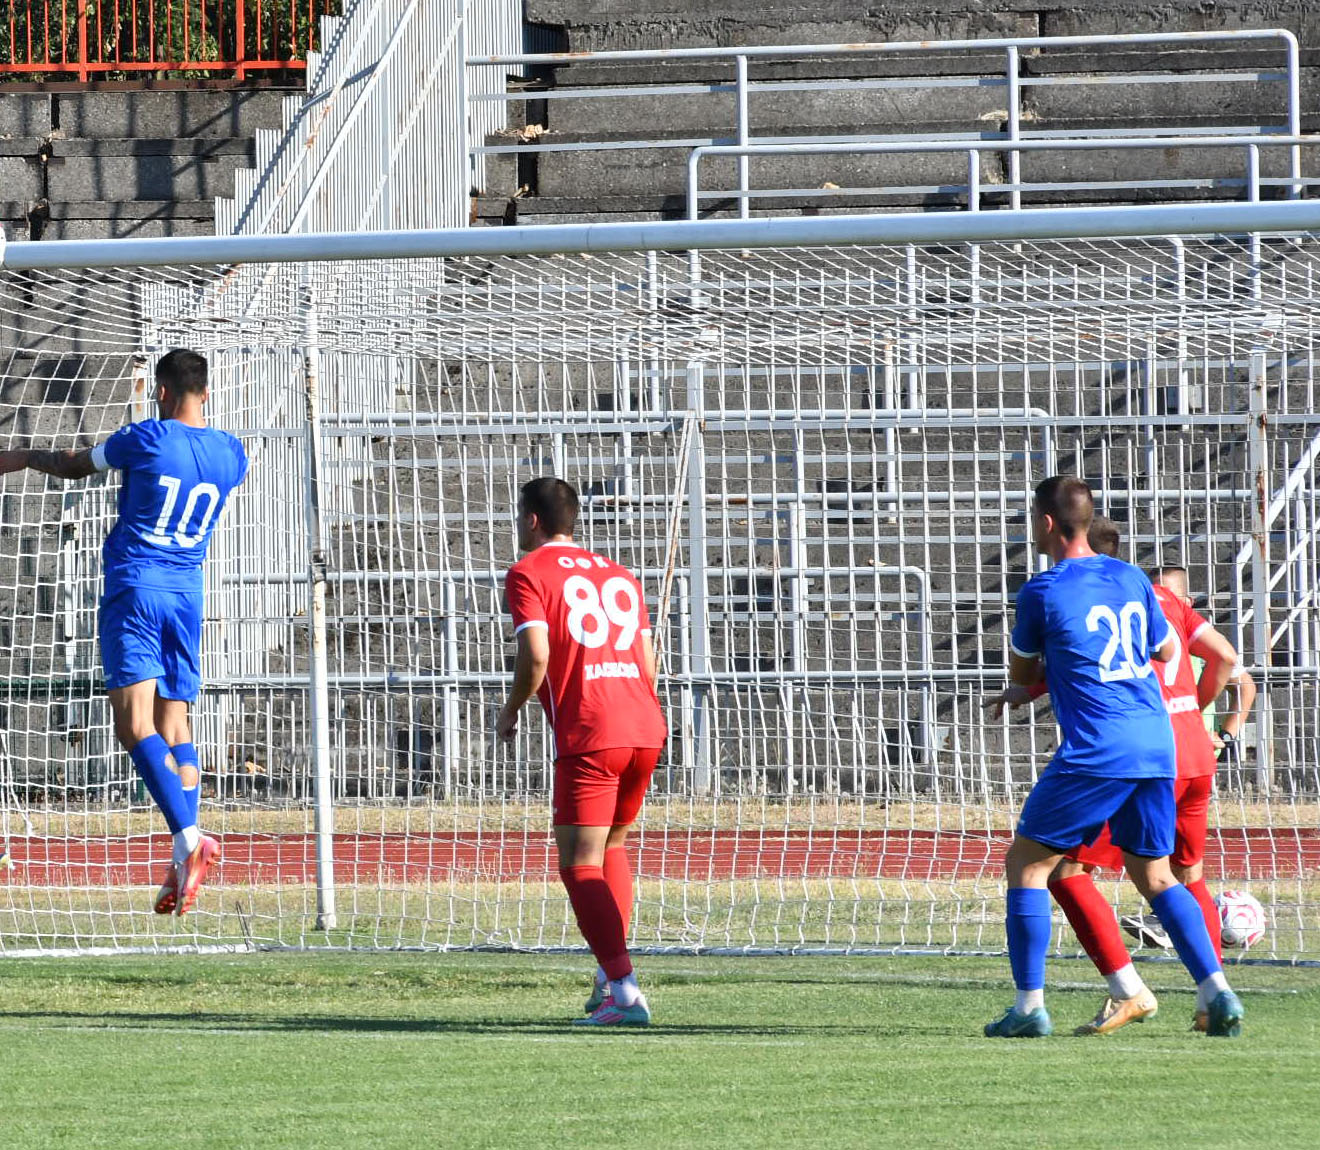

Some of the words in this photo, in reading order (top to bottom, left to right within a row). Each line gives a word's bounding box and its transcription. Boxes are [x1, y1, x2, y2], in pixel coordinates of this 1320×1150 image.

[140, 475, 220, 547] 10
[558, 556, 609, 568] ОФК
[563, 575, 639, 651] 89
[1086, 602, 1152, 681] 20
